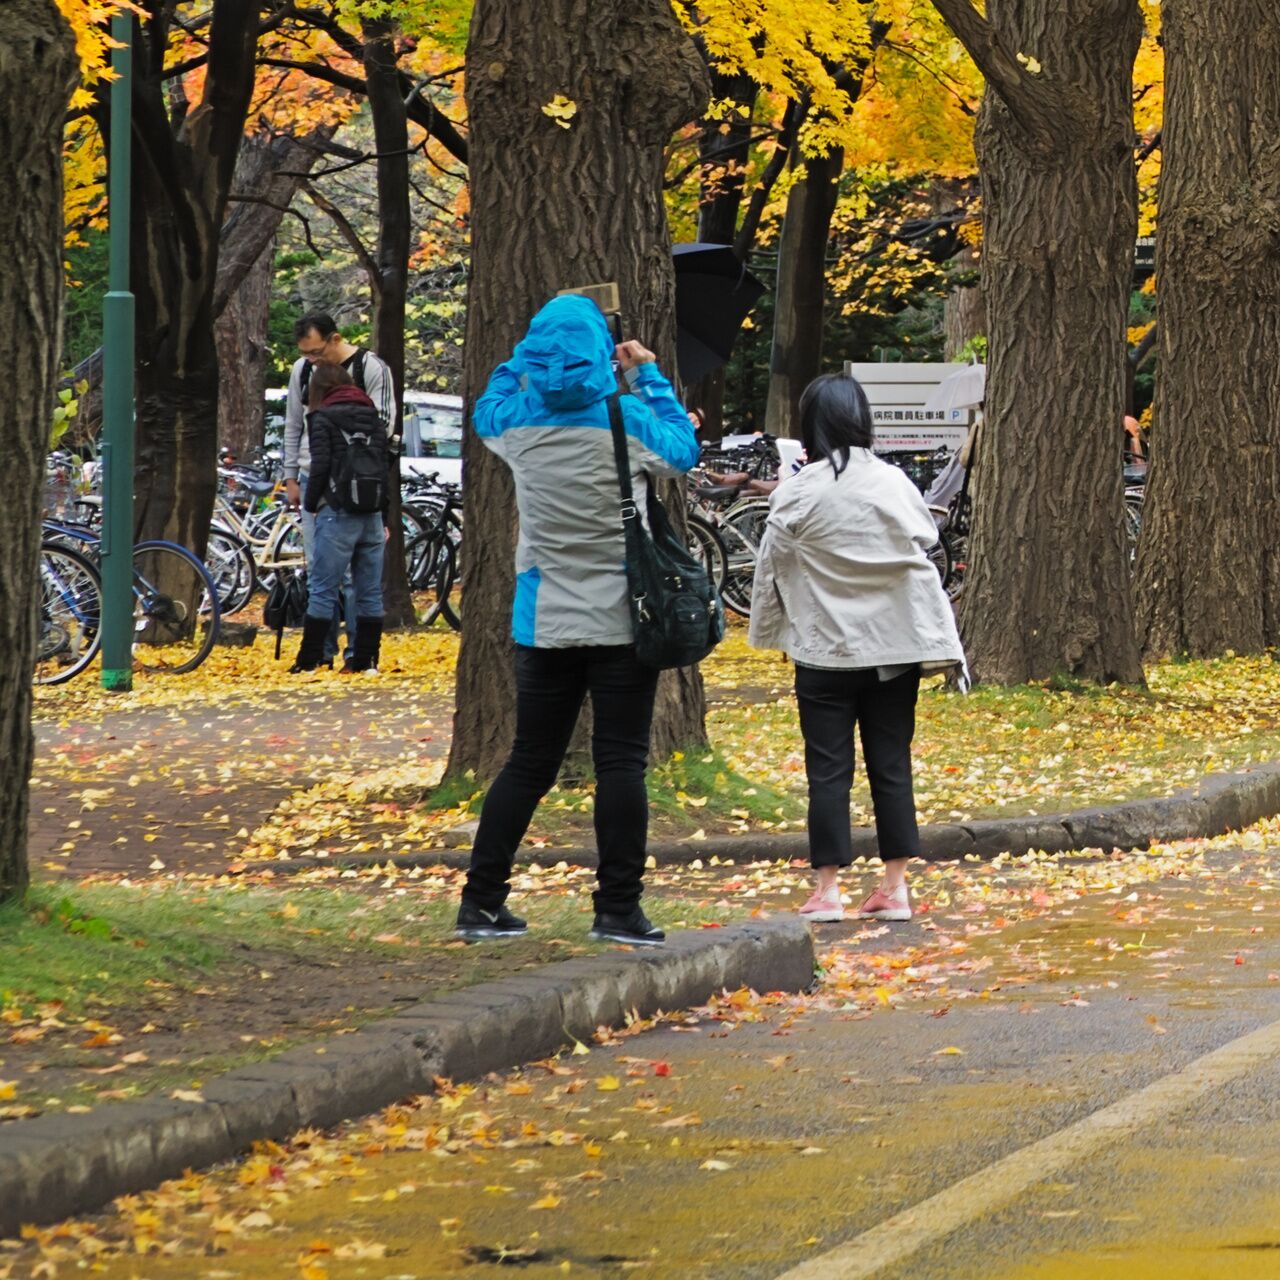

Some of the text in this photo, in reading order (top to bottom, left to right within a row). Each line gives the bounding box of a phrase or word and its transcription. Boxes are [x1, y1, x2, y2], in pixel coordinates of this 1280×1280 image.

[873, 410, 945, 421] 病院職員駐車場
